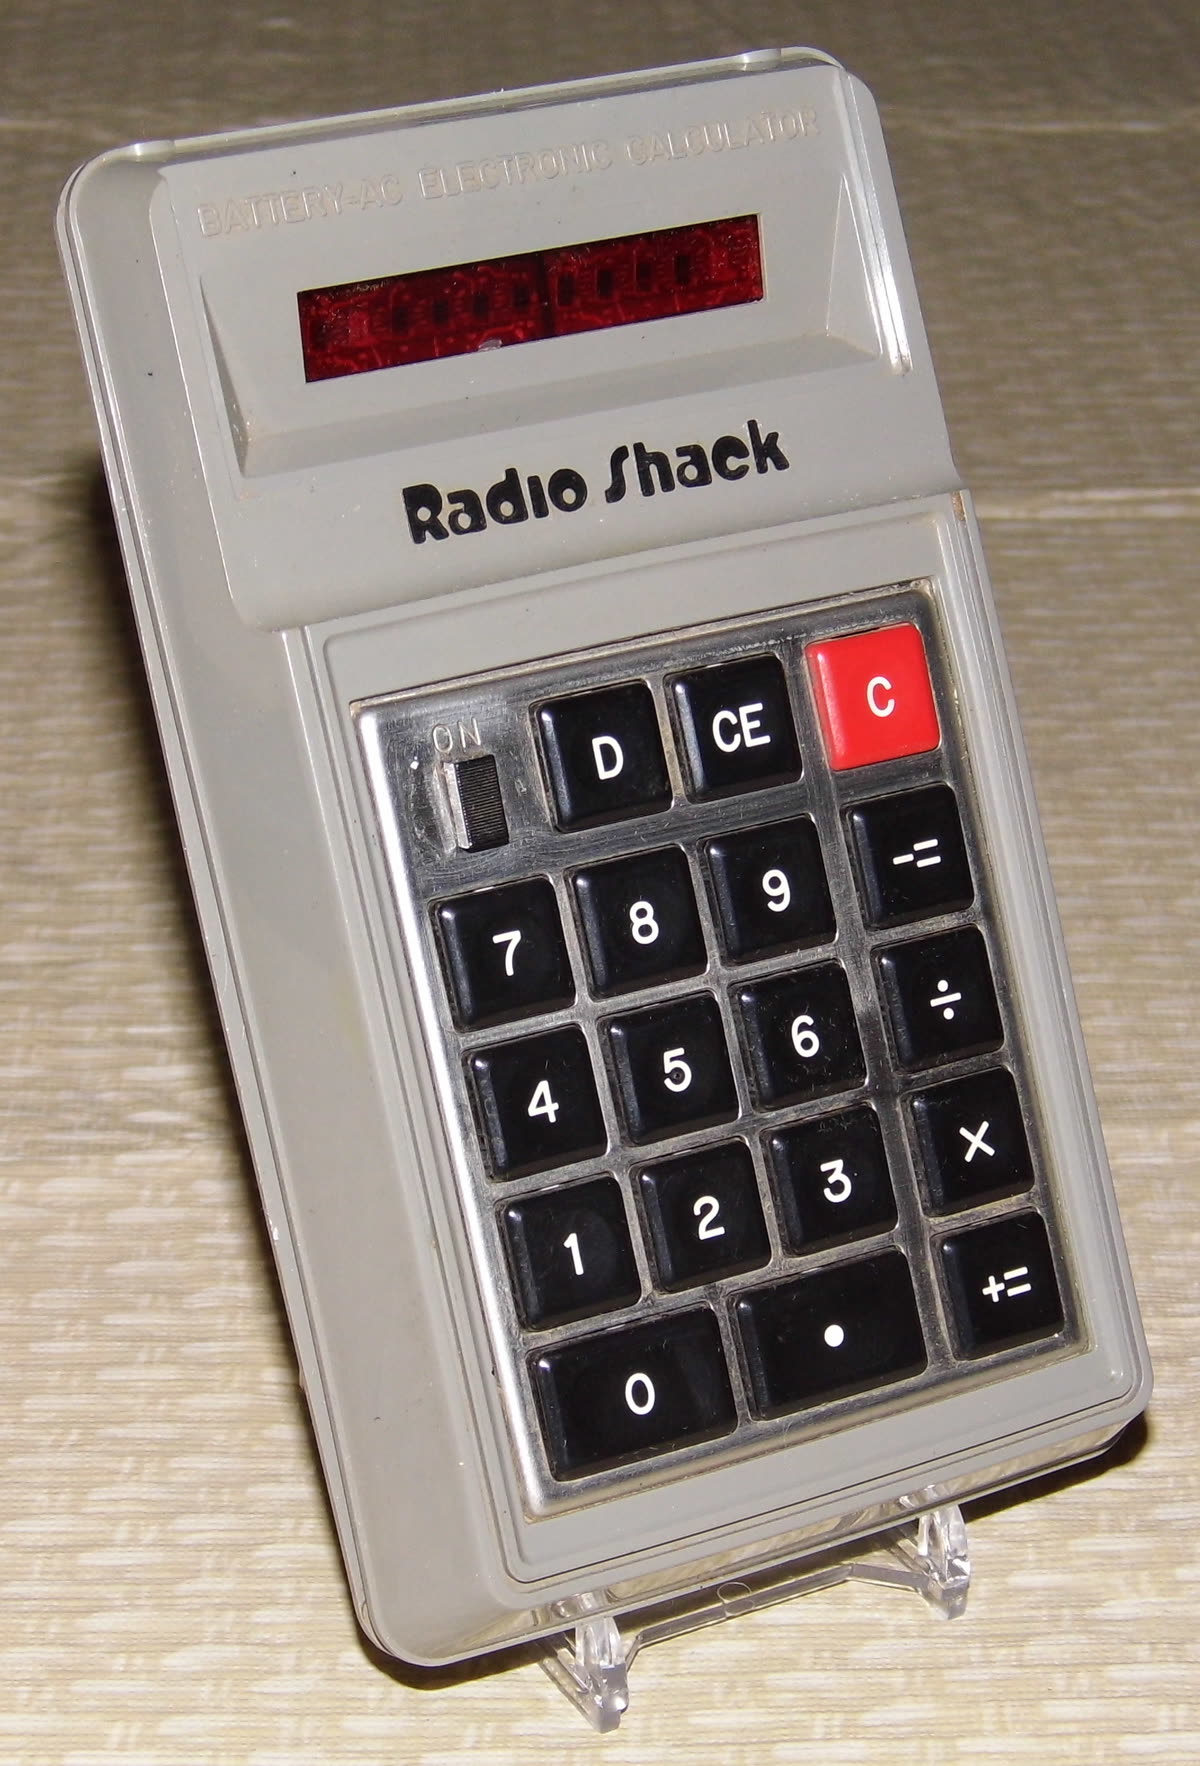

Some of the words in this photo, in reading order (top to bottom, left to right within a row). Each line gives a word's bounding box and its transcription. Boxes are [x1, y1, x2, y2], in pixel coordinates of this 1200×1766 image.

[197, 173, 403, 238] BATTERY-AC
[417, 141, 614, 201] ELECTRONIC
[624, 107, 821, 166] CALCULATOR
[402, 467, 588, 544] Radio
[605, 419, 790, 503] Shack
[866, 675, 896, 718] C
[431, 718, 482, 755] ON
[712, 702, 771, 753] CE
[591, 735, 624, 780] D
[762, 869, 791, 912] 9
[629, 900, 659, 945] 8
[492, 929, 522, 977] 7
[791, 1014, 820, 1058] 6
[663, 1047, 692, 1093] 5
[527, 1080, 560, 1123] 4
[820, 1158, 852, 1203] 3
[693, 1195, 726, 1241] 2
[563, 1232, 584, 1276] 1
[624, 1372, 656, 1415] 0
